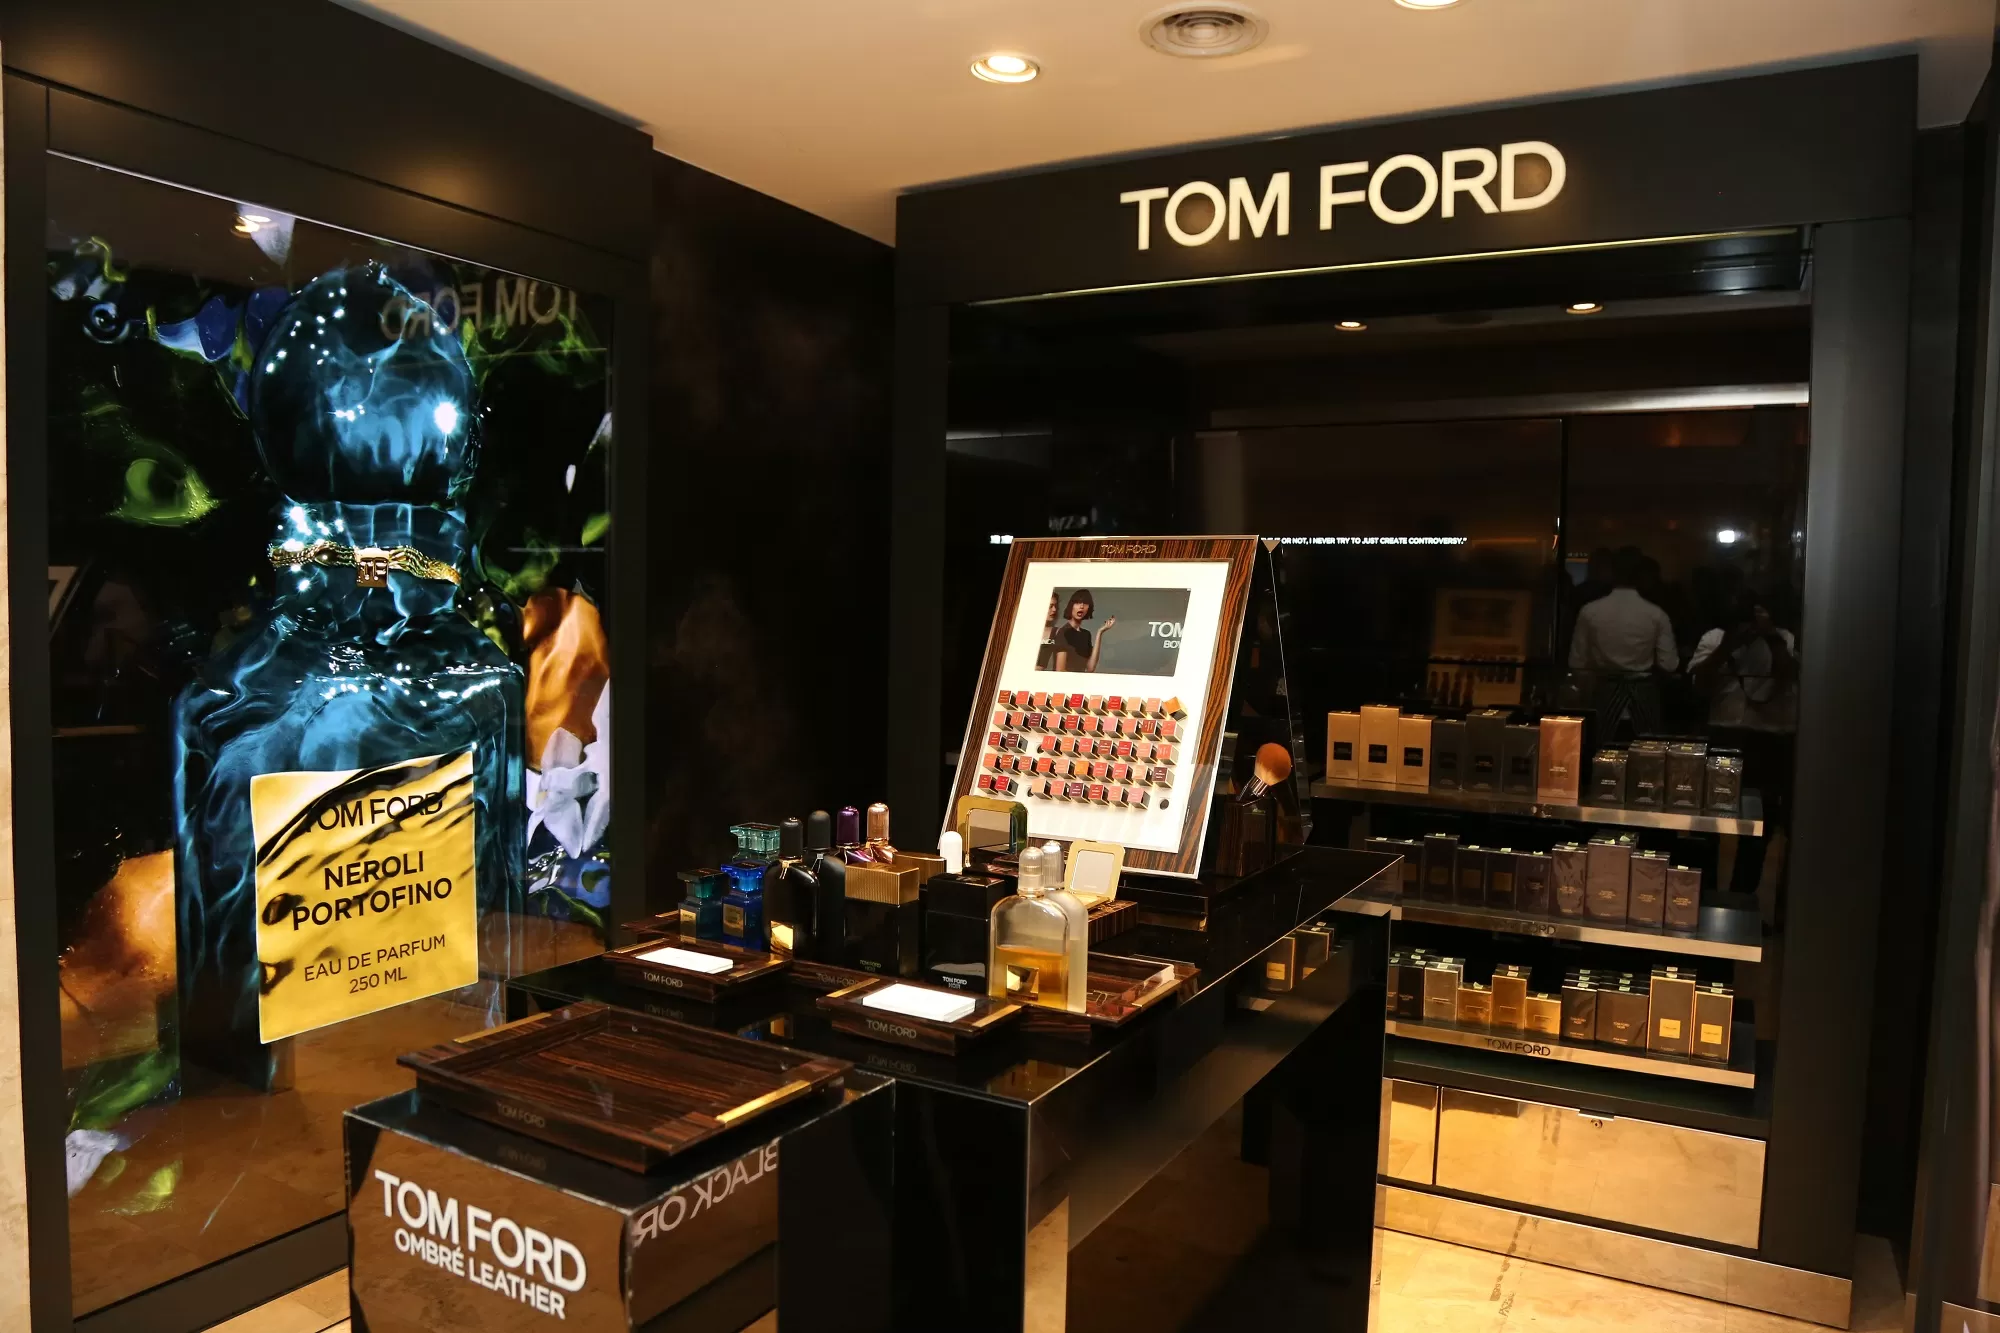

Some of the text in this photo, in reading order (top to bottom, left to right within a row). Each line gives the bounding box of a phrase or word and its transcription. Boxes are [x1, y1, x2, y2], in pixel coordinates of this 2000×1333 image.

[1120, 140, 1567, 250] TOM FORD
[1101, 544, 1157, 554] TOM FORD
[1281, 537, 1291, 545] OR
[1292, 537, 1308, 545] NOT,
[1313, 537, 1335, 545] NEVER
[1336, 537, 1350, 545] TRY
[1351, 537, 1361, 545] TO
[1362, 537, 1379, 545] JUST
[1380, 537, 1408, 545] CREATE
[371, 791, 443, 826] FORD
[324, 851, 424, 890] NEROLI
[292, 877, 452, 931] PORTOFINO
[304, 934, 446, 982] EAU DE PARFUM
[349, 967, 407, 994] 250 ML
[643, 971, 684, 988] TOM FORD
[866, 1019, 917, 1039] TOM FORD
[1485, 1037, 1551, 1057] TOM FORD
[374, 1170, 587, 1292] TOM FORD
[394, 1227, 566, 1319] OMBRÉ LEATHER
